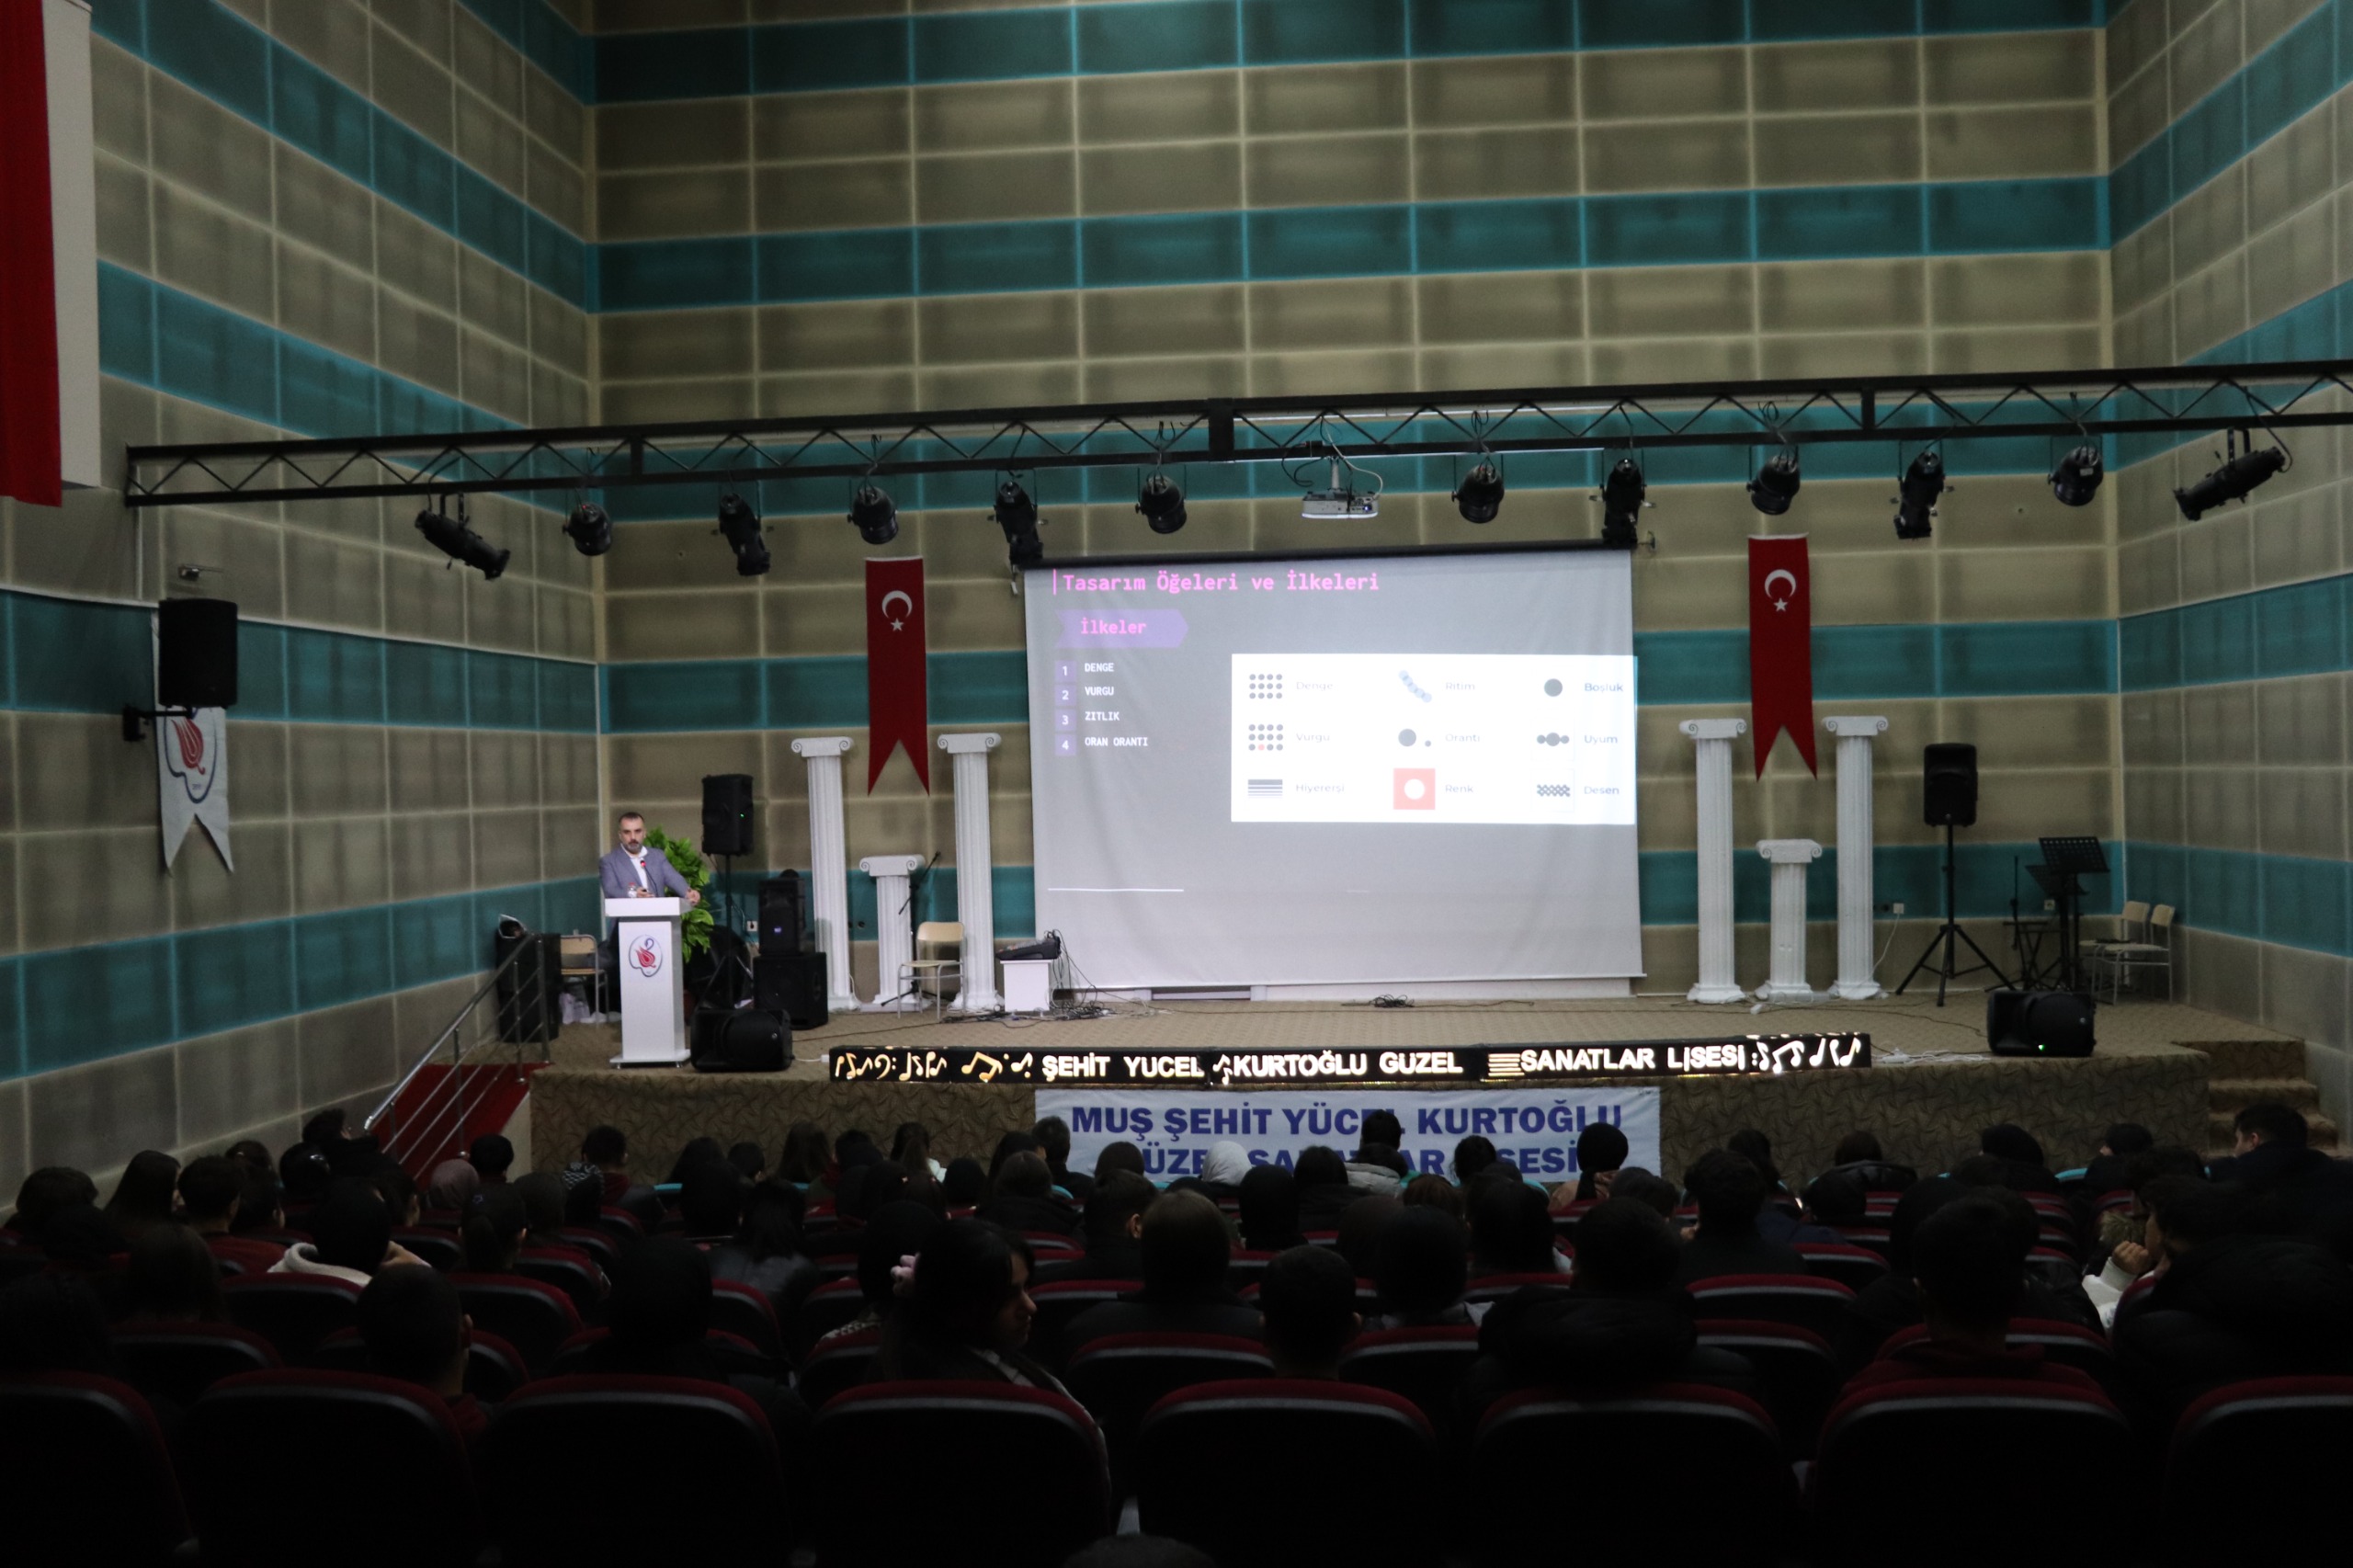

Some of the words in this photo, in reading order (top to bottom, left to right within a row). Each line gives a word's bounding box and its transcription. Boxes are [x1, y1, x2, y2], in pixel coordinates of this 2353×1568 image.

[1063, 574, 1146, 591] Tasarım
[1156, 570, 1238, 594] Öğeleri
[1251, 576, 1275, 591] ve
[1287, 569, 1380, 591] İlkeleri
[1081, 617, 1147, 634] İlkeler
[1062, 665, 1068, 676] 1
[1084, 663, 1115, 673] DENGE
[1295, 681, 1334, 692] Denge
[1445, 681, 1476, 691] Ritim
[1584, 682, 1624, 693] Boşluk
[1061, 689, 1070, 700] 2
[1084, 687, 1115, 697] VURGU
[1061, 714, 1069, 725] 3
[1084, 710, 1120, 722] ZITLIK
[1061, 739, 1069, 750] 4
[1084, 736, 1108, 746] ORAN
[1112, 736, 1149, 746] ORANTI
[1295, 733, 1331, 744] Vurgu
[1584, 734, 1619, 745] Uyum
[1444, 784, 1474, 793] Renk
[1583, 785, 1620, 795] Desen
[1042, 1051, 1111, 1082] ŞEHİT
[1233, 1050, 1368, 1077] KURTOĞLU
[1520, 1047, 1656, 1073] SANATLAR
[1072, 1106, 1154, 1142] MUŞ
[1163, 1101, 1273, 1142] ŞEHİT
